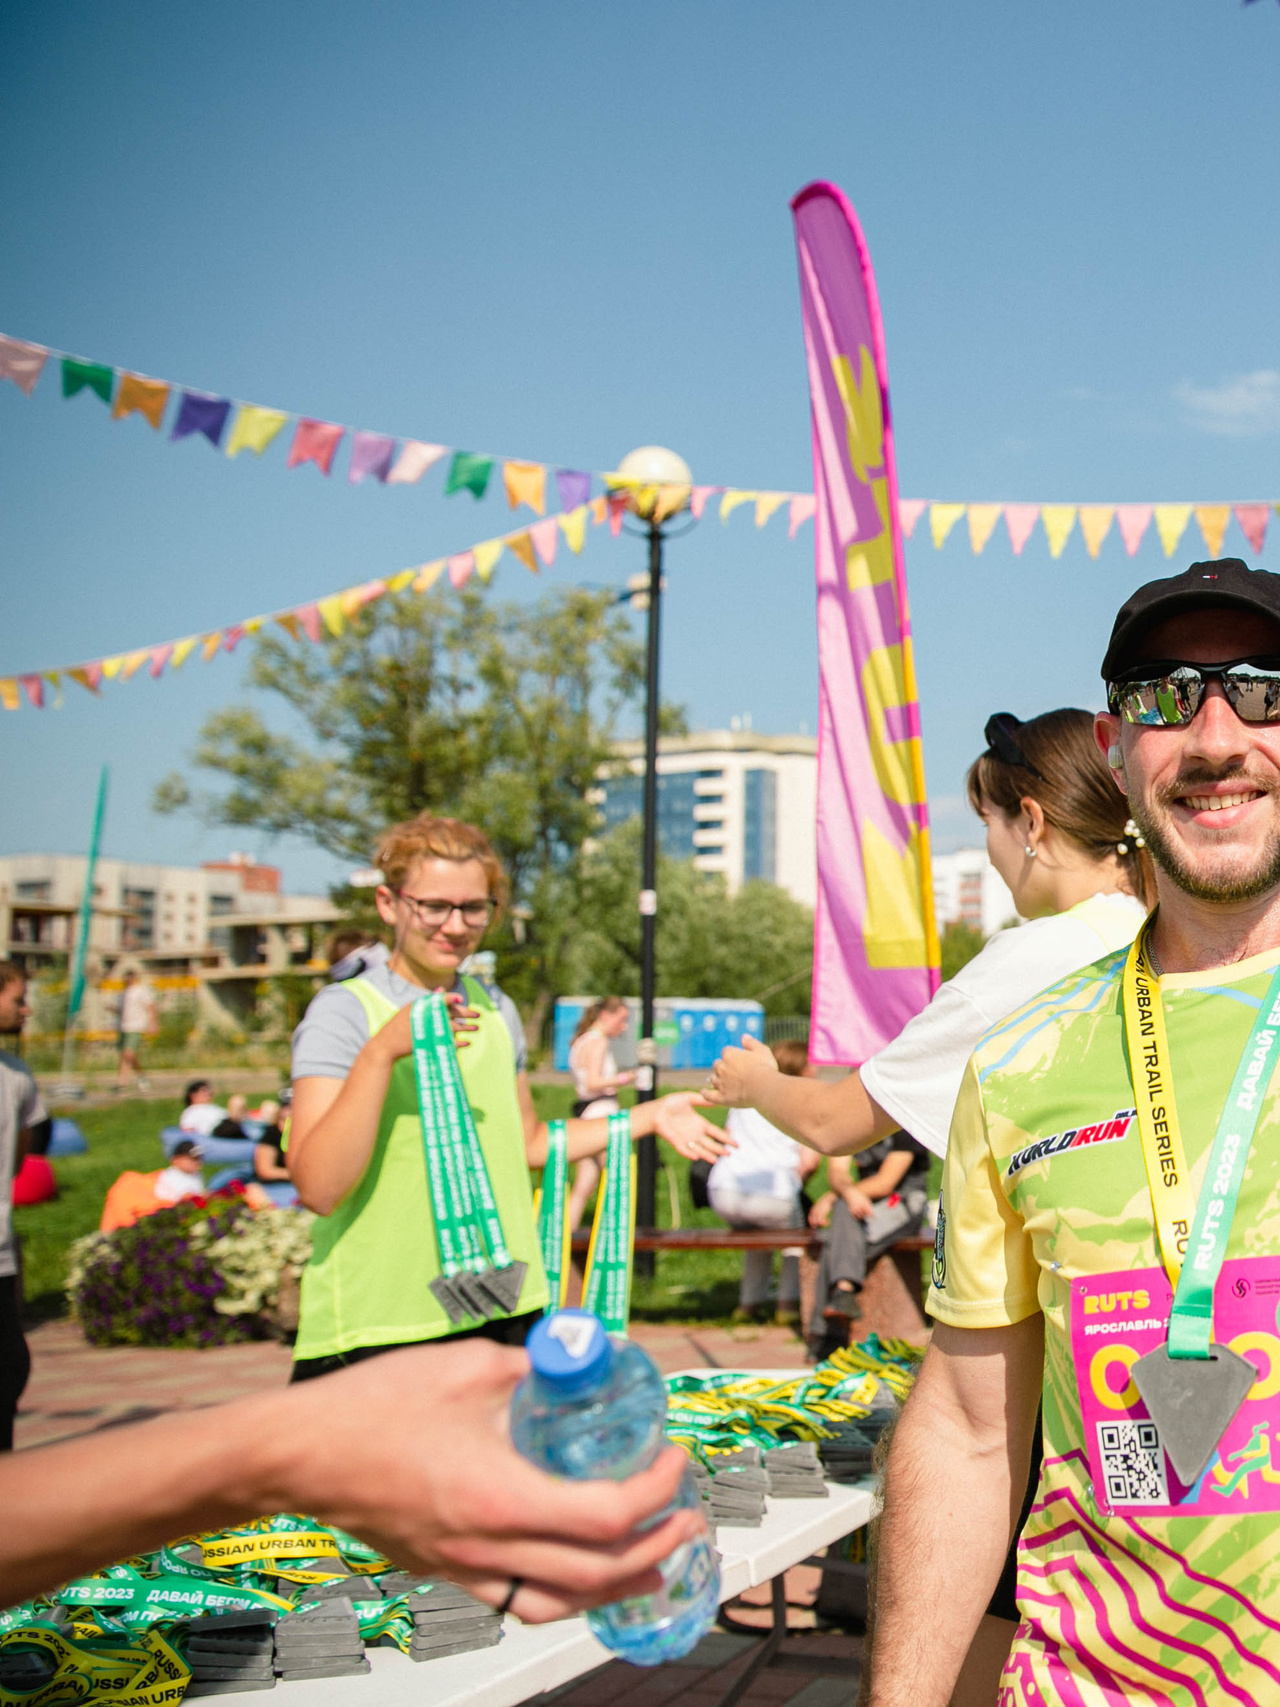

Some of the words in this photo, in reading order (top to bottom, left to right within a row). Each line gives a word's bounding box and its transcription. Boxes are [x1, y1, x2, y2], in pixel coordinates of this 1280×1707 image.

[1135, 976, 1155, 1037] URBAN
[1143, 1041, 1164, 1103] TRAIL
[1236, 1029, 1277, 1111] ДАВАЙ
[1151, 1106, 1179, 1188] SERIES
[1193, 1198, 1224, 1271] RUTS
[1212, 1132, 1241, 1196] 2023
[1084, 1289, 1151, 1315] RUTS
[1084, 1318, 1162, 1336] ЯРОСЛАВЛЬ
[259, 1537, 316, 1550] URBAN
[93, 1587, 135, 1599] 2023
[146, 1589, 203, 1606] ДАВАЙ
